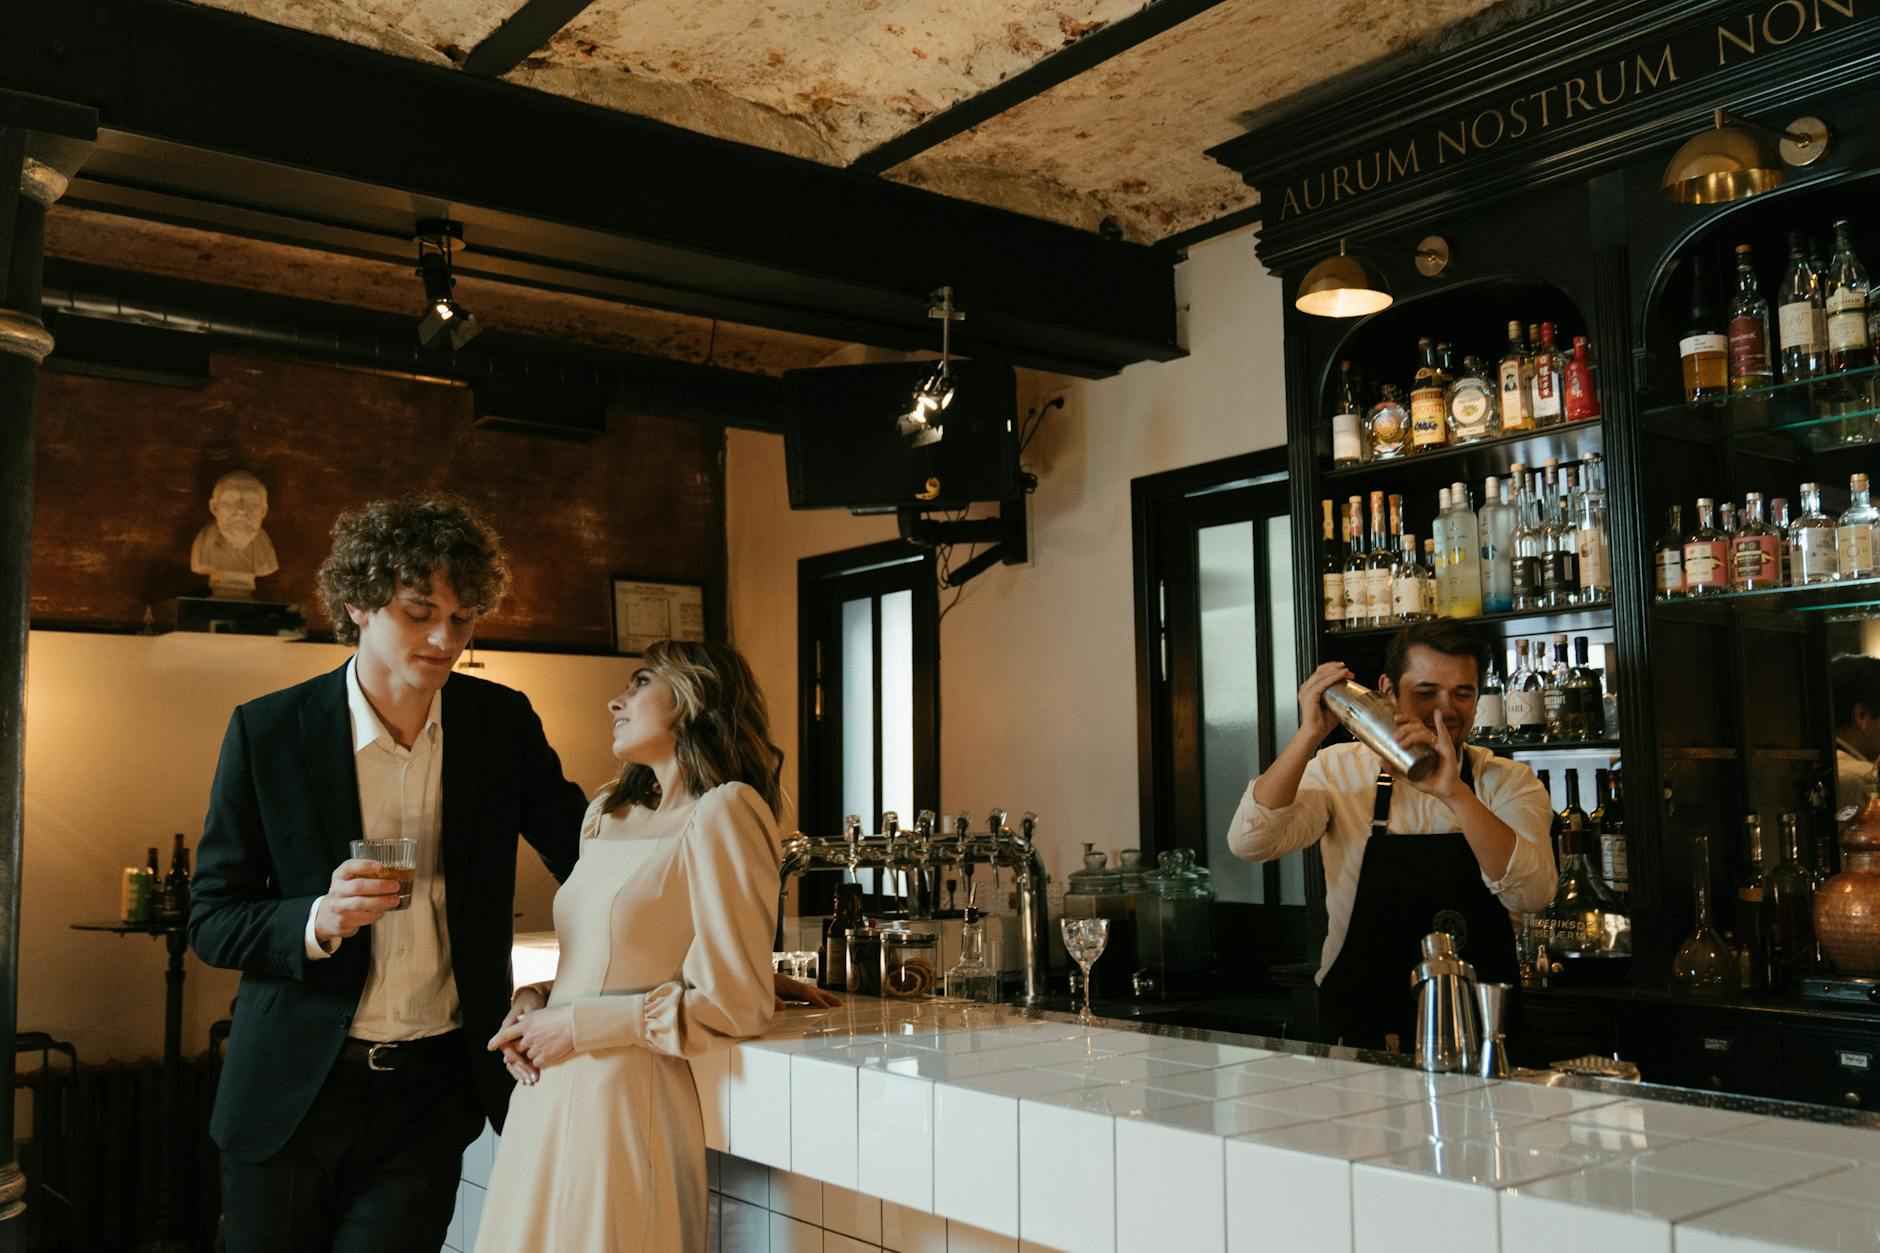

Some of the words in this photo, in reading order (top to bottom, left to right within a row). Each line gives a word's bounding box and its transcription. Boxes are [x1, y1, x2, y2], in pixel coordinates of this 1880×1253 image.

[1280, 138, 1420, 221] AURUM
[1437, 43, 1680, 165] NOSTRUM
[1716, 0, 1856, 65] NON
